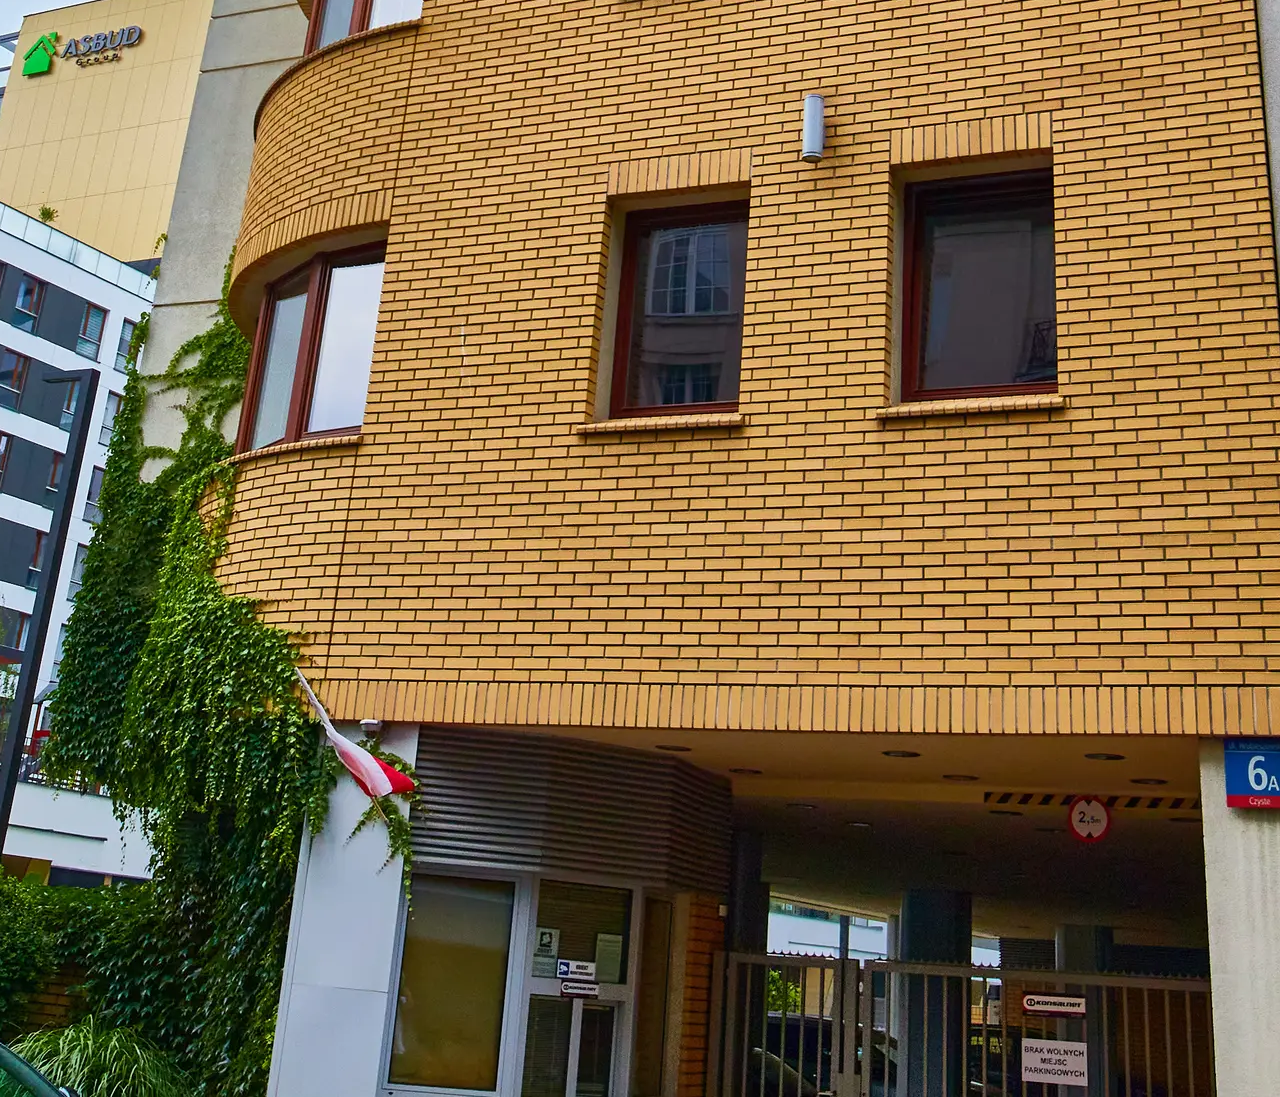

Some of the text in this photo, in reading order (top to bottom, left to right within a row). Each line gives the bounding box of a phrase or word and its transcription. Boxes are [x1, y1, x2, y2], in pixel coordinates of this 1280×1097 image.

[60, 25, 142, 58] ASBUD
[76, 52, 119, 67] Group
[1248, 755, 1280, 791] 6A
[1248, 796, 1272, 807] Czyste
[1024, 1045, 1085, 1058] BRAK WOLNYCH
[1024, 1066, 1085, 1078] PARKINGOWYCH
